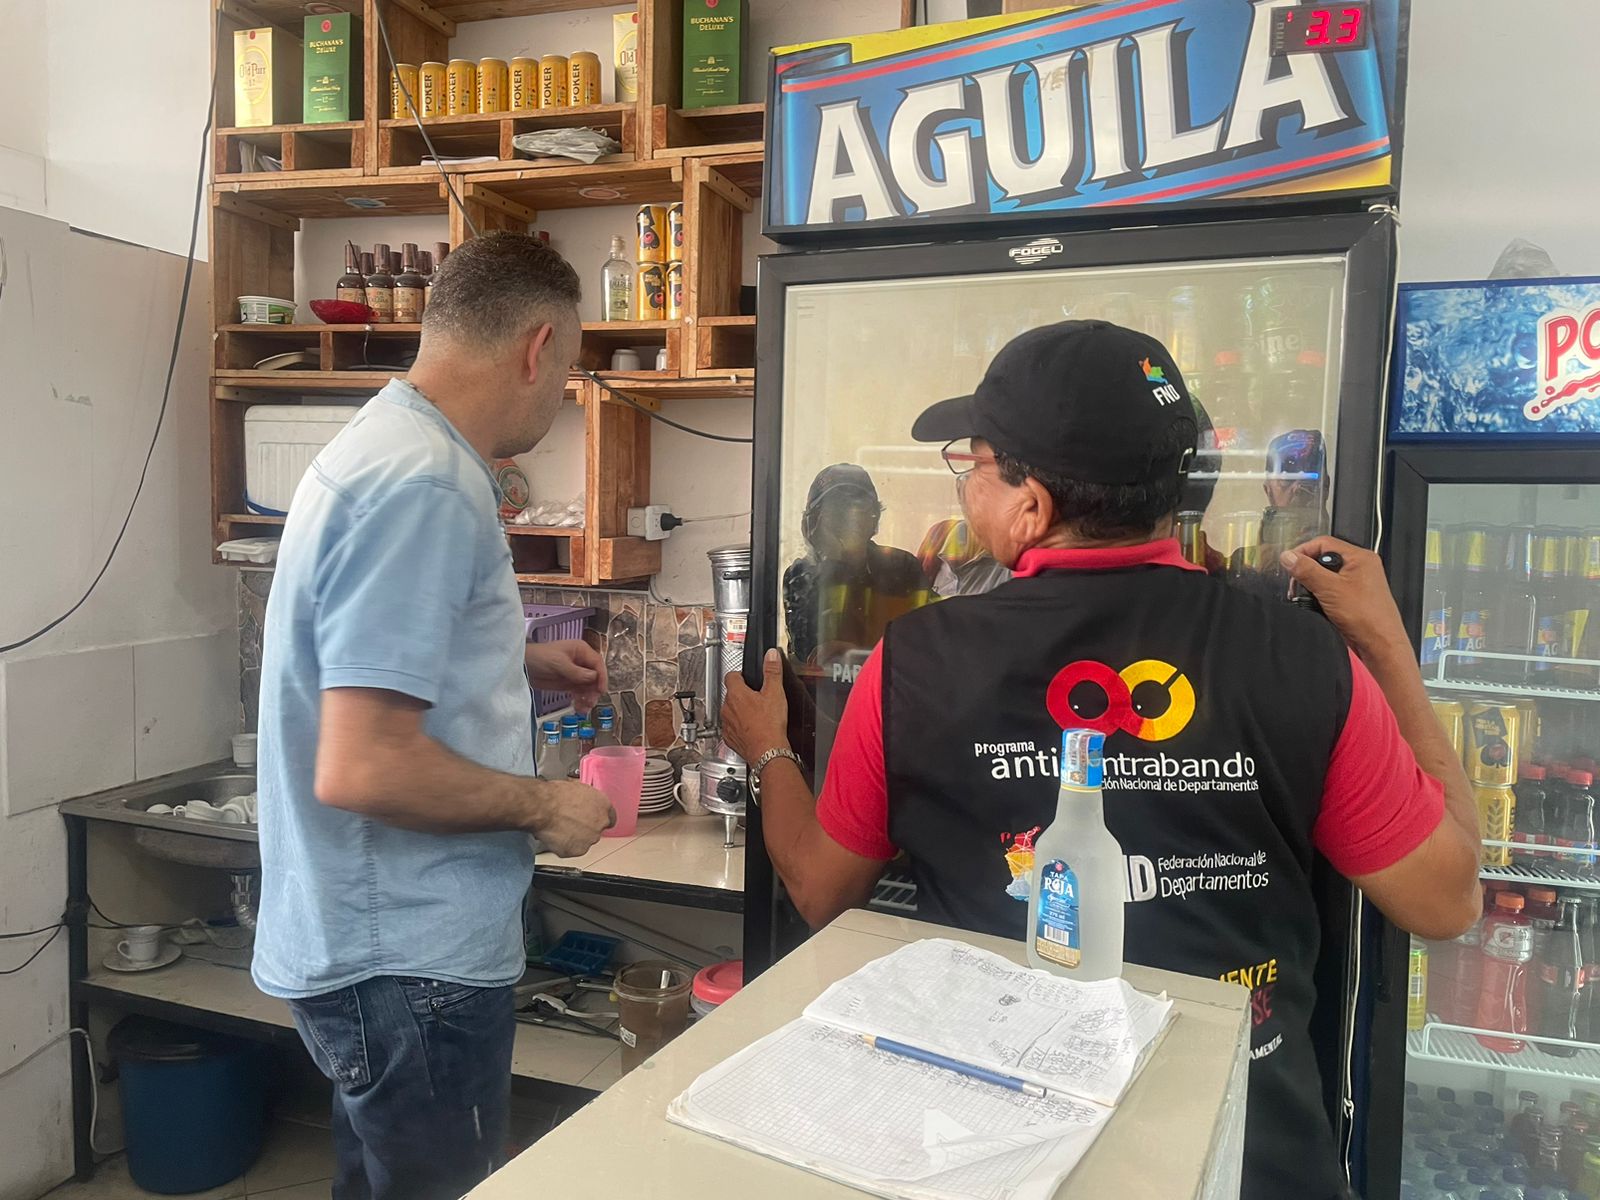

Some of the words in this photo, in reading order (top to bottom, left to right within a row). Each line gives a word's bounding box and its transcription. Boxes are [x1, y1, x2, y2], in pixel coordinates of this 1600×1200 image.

[690, 16, 735, 25] BUCHANAN'S
[309, 38, 344, 49] BUCHANAN'S
[424, 74, 433, 112] POKER
[448, 71, 457, 110] POKER
[513, 69, 522, 108] POKER
[543, 66, 552, 106] POKER
[572, 63, 580, 103] POKER
[805, 0, 1350, 226] AGUILA
[1152, 384, 1180, 406] FND
[974, 739, 1036, 758] programa
[1120, 777, 1162, 792] Nacional
[1163, 778, 1178, 792] de
[1178, 778, 1260, 795] Departamentos
[1157, 853, 1215, 874] Federación
[1214, 851, 1257, 869] Nacional
[1043, 876, 1075, 898] ROJA
[1160, 869, 1270, 901] Departamentos
